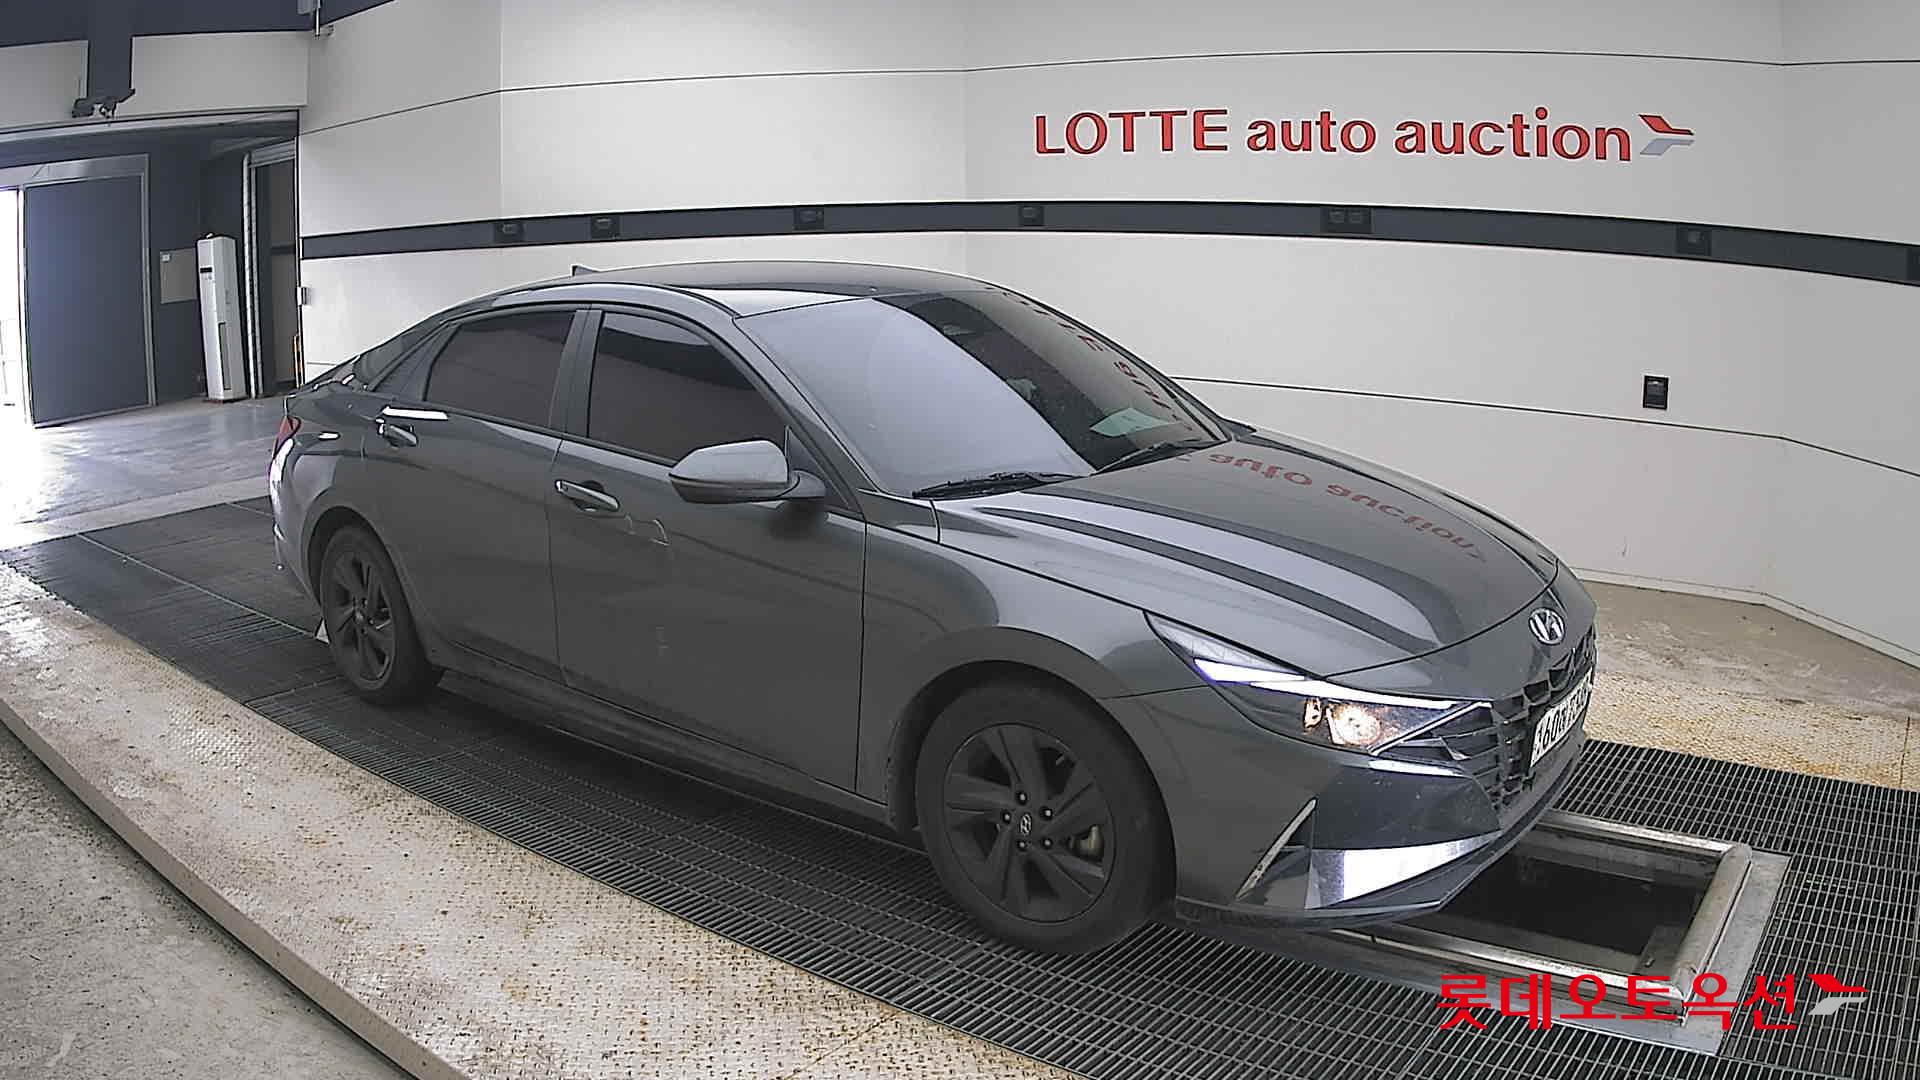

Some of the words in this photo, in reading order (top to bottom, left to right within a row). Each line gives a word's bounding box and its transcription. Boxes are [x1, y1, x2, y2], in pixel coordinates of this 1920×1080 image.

[1034, 109, 1228, 156] LOTTE
[1245, 110, 1376, 154] auto
[1393, 106, 1633, 162] auction
